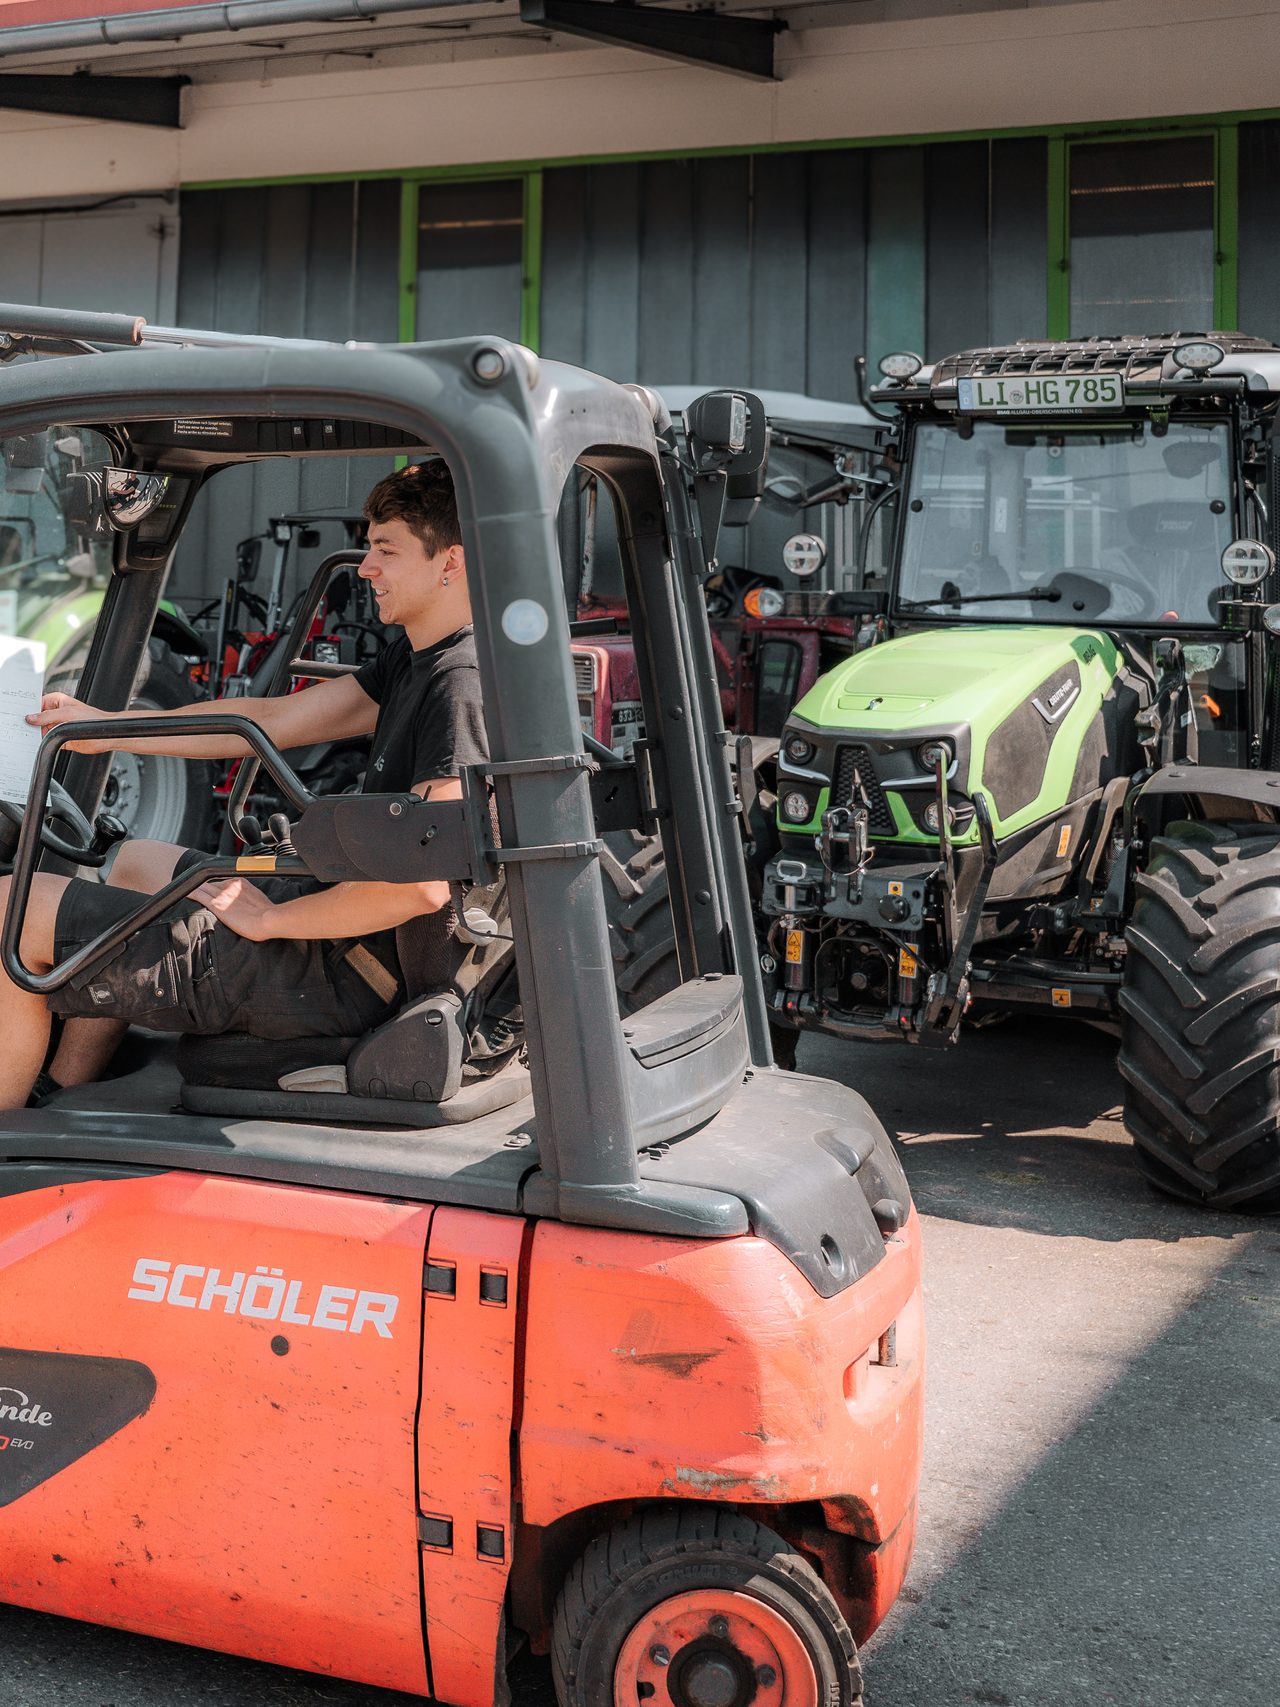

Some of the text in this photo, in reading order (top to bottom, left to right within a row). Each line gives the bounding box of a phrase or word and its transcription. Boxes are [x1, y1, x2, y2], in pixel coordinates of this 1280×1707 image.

[977, 378, 1117, 406] LI HG 785
[127, 1257, 400, 1339] SCHÖLER
